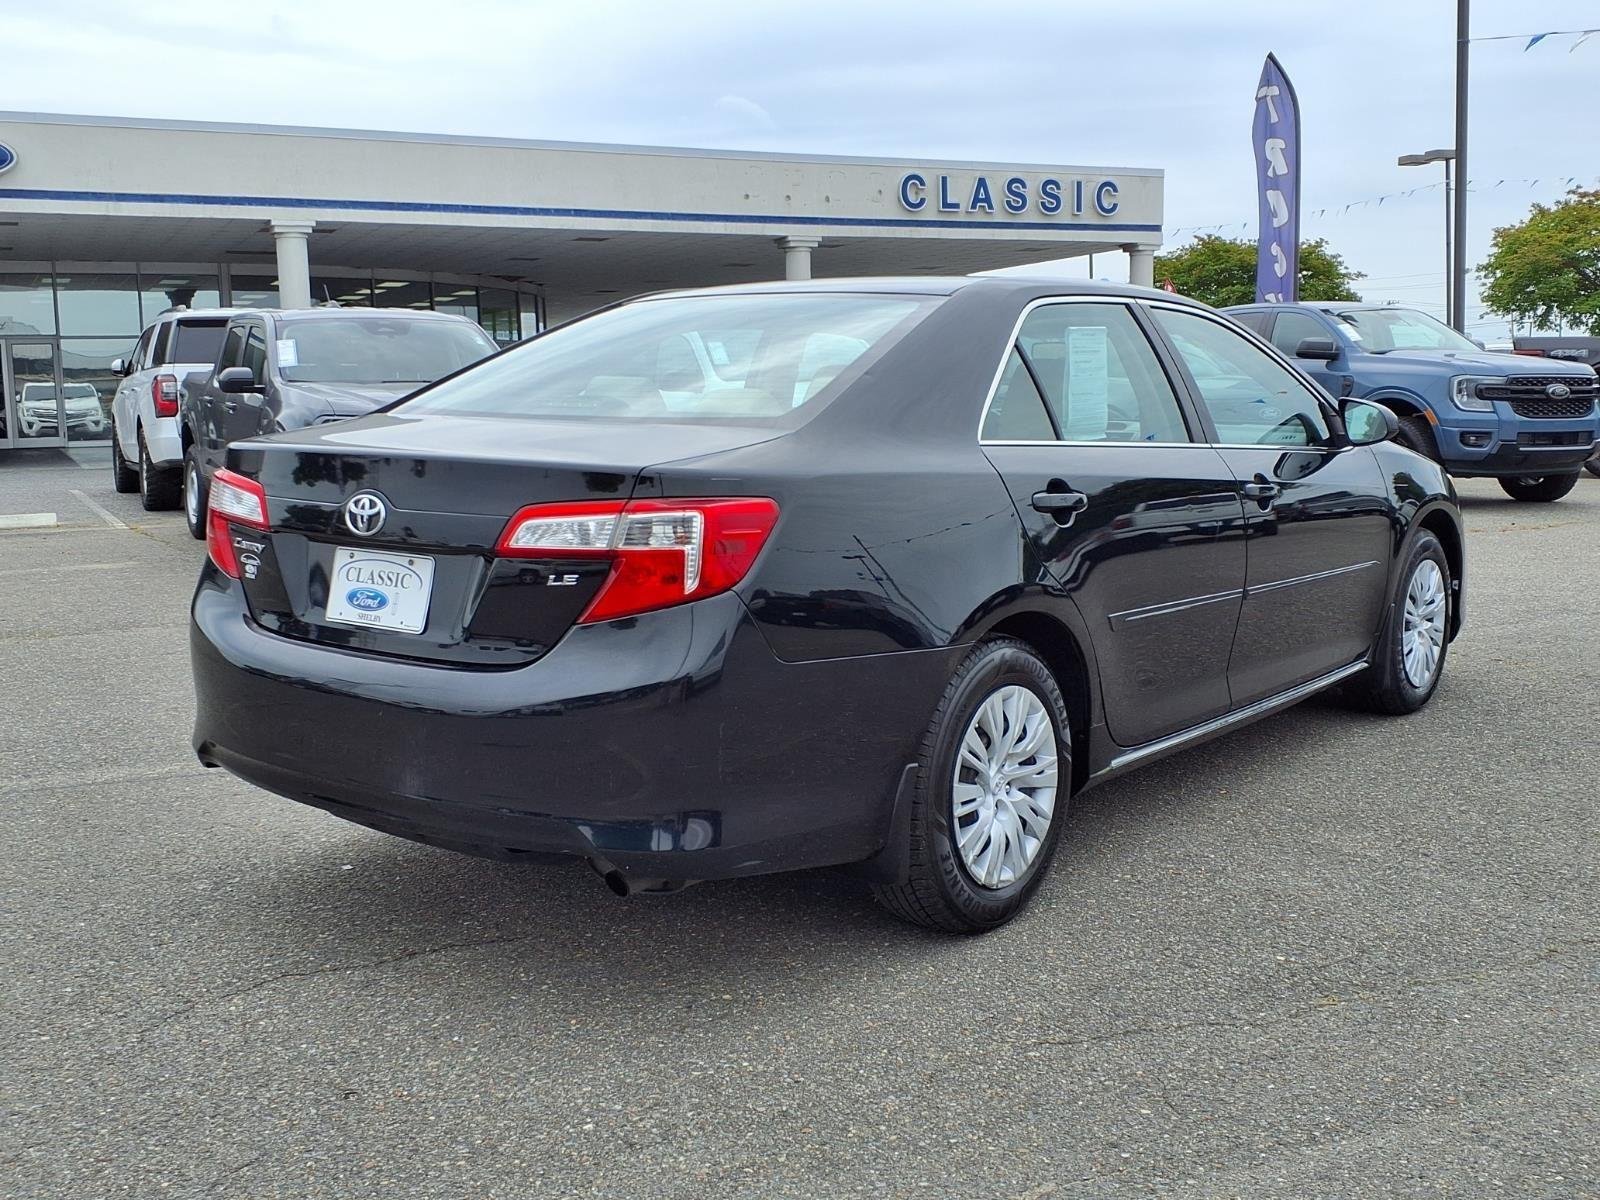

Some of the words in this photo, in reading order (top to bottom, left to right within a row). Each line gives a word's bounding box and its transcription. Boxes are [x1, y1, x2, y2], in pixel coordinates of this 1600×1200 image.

[899, 171, 1120, 216] CLASSIC
[345, 566, 413, 590] CLASSIC
[546, 574, 580, 586] LE
[353, 590, 381, 608] Ford
